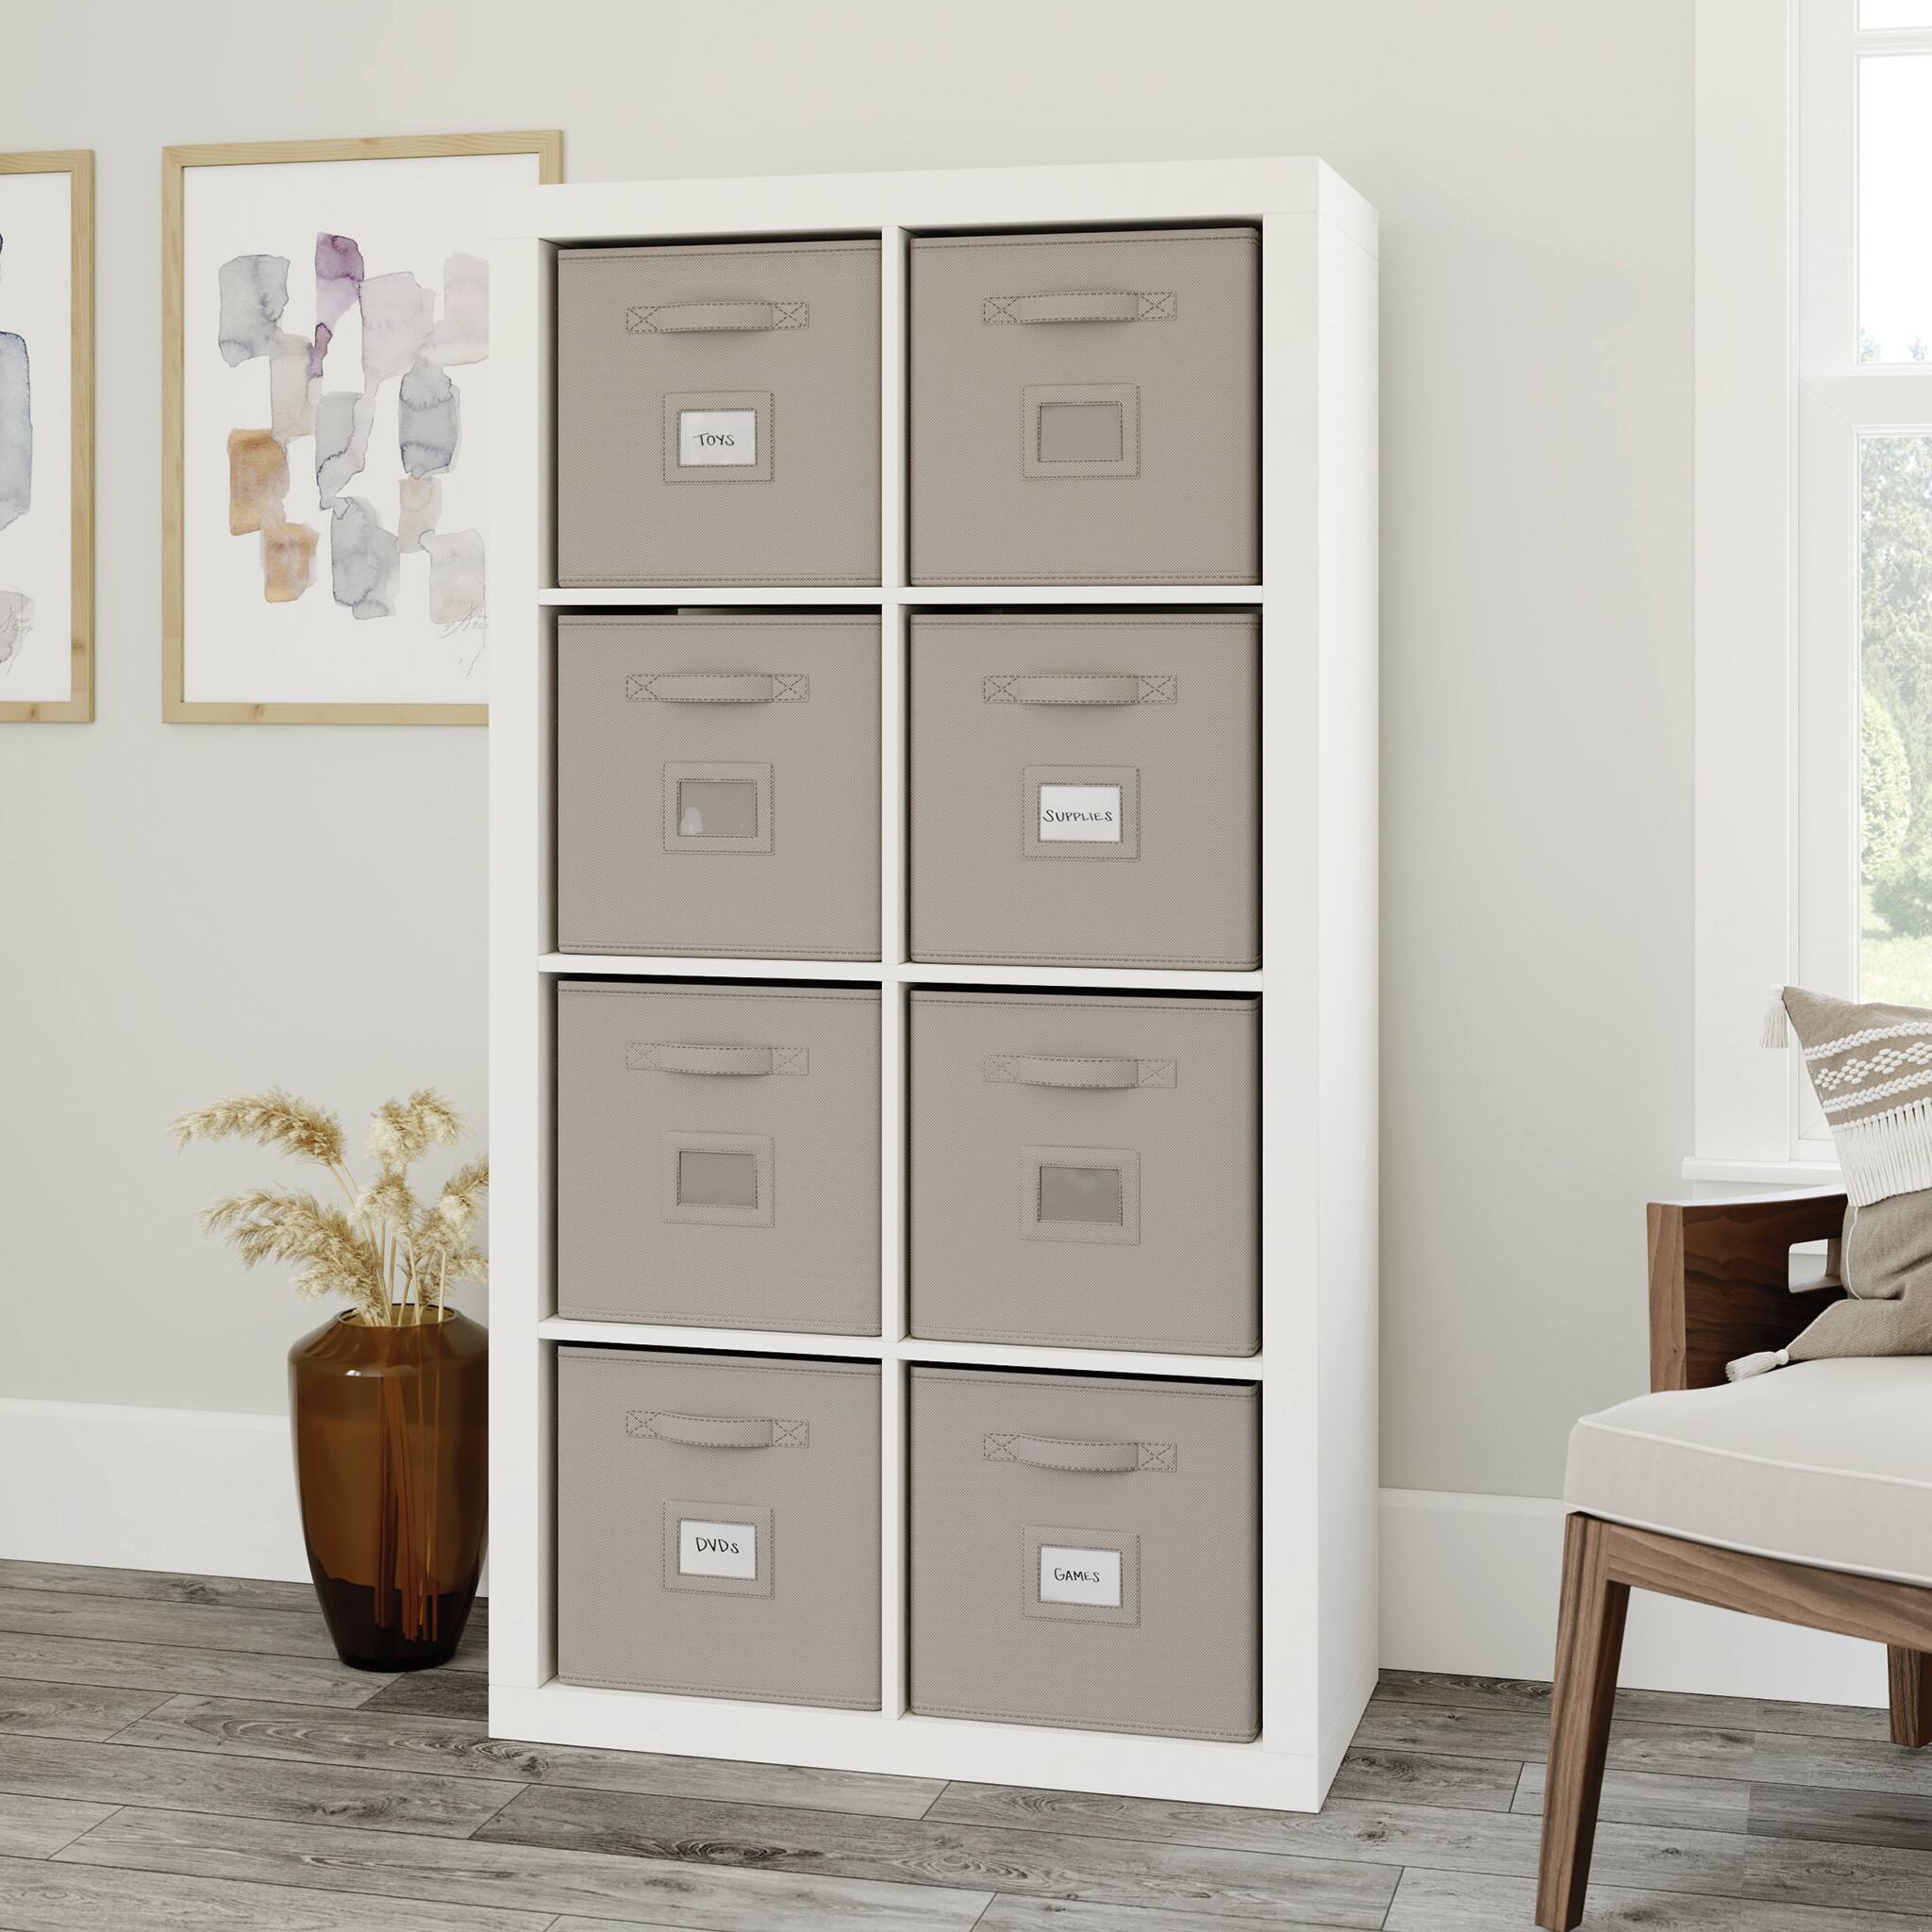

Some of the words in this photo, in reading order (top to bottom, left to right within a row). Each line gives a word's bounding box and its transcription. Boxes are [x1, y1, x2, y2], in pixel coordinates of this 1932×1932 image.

[692, 432, 735, 446] TOYS
[1042, 808, 1113, 823] SUPPLIES
[1054, 1567, 1100, 1583] GAMES
